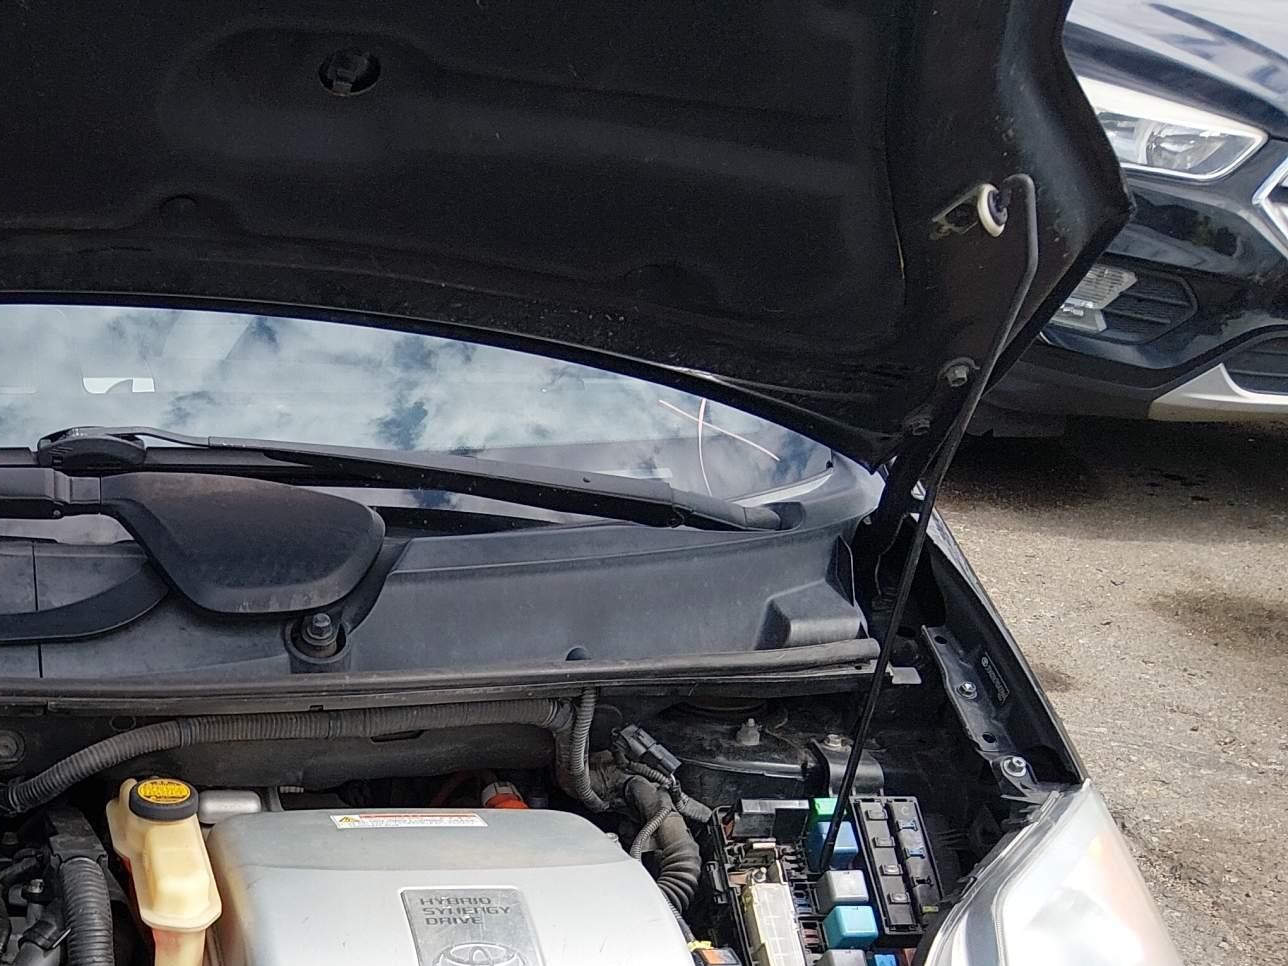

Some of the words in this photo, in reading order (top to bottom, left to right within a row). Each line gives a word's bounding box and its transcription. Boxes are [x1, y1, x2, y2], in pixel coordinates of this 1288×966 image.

[420, 897, 491, 905] HYBRID
[422, 906, 510, 915] SYNERGY
[425, 917, 483, 925] DRIVE
